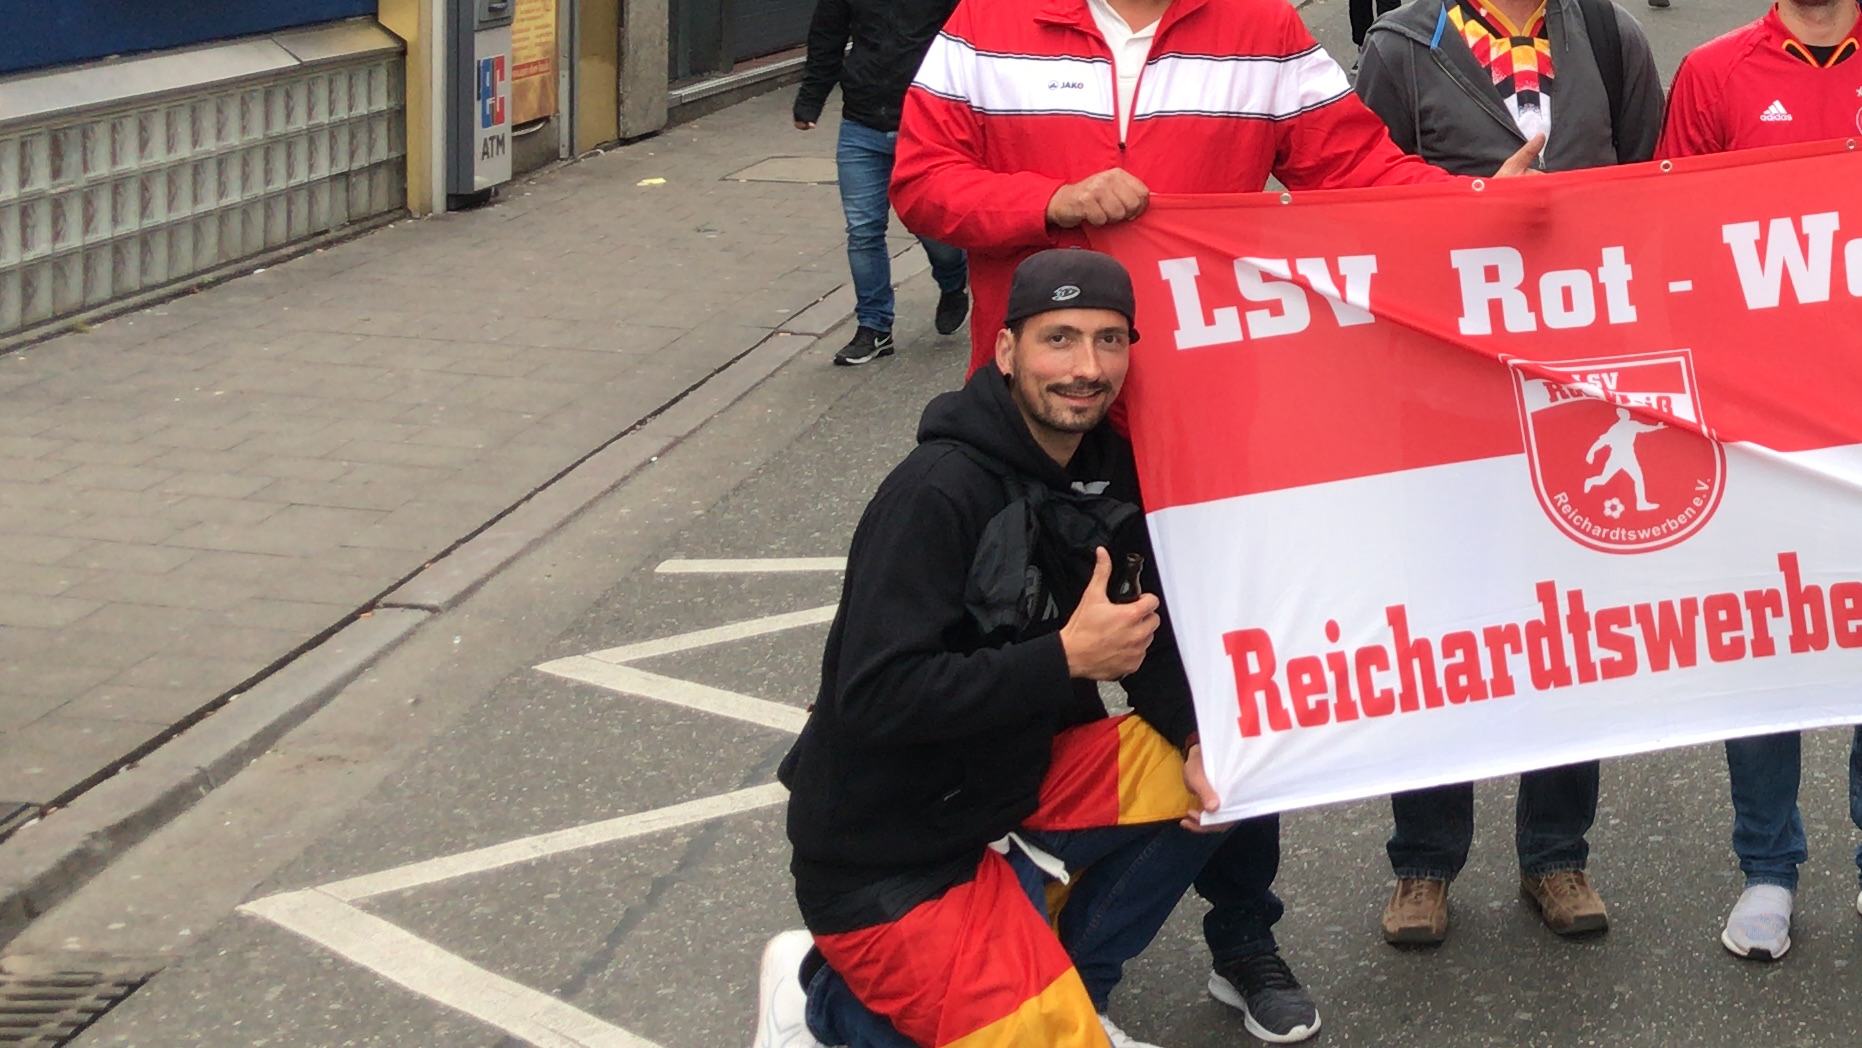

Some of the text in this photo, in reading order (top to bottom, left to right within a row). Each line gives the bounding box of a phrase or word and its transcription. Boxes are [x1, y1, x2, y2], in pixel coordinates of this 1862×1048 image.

[1060, 81, 1085, 90] JAKO
[1759, 113, 1793, 122] adidas
[481, 135, 505, 161] ATM
[1158, 254, 1377, 350] LSV
[1450, 245, 1637, 337] Rot
[1553, 491, 1697, 542] Reichardtswerben
